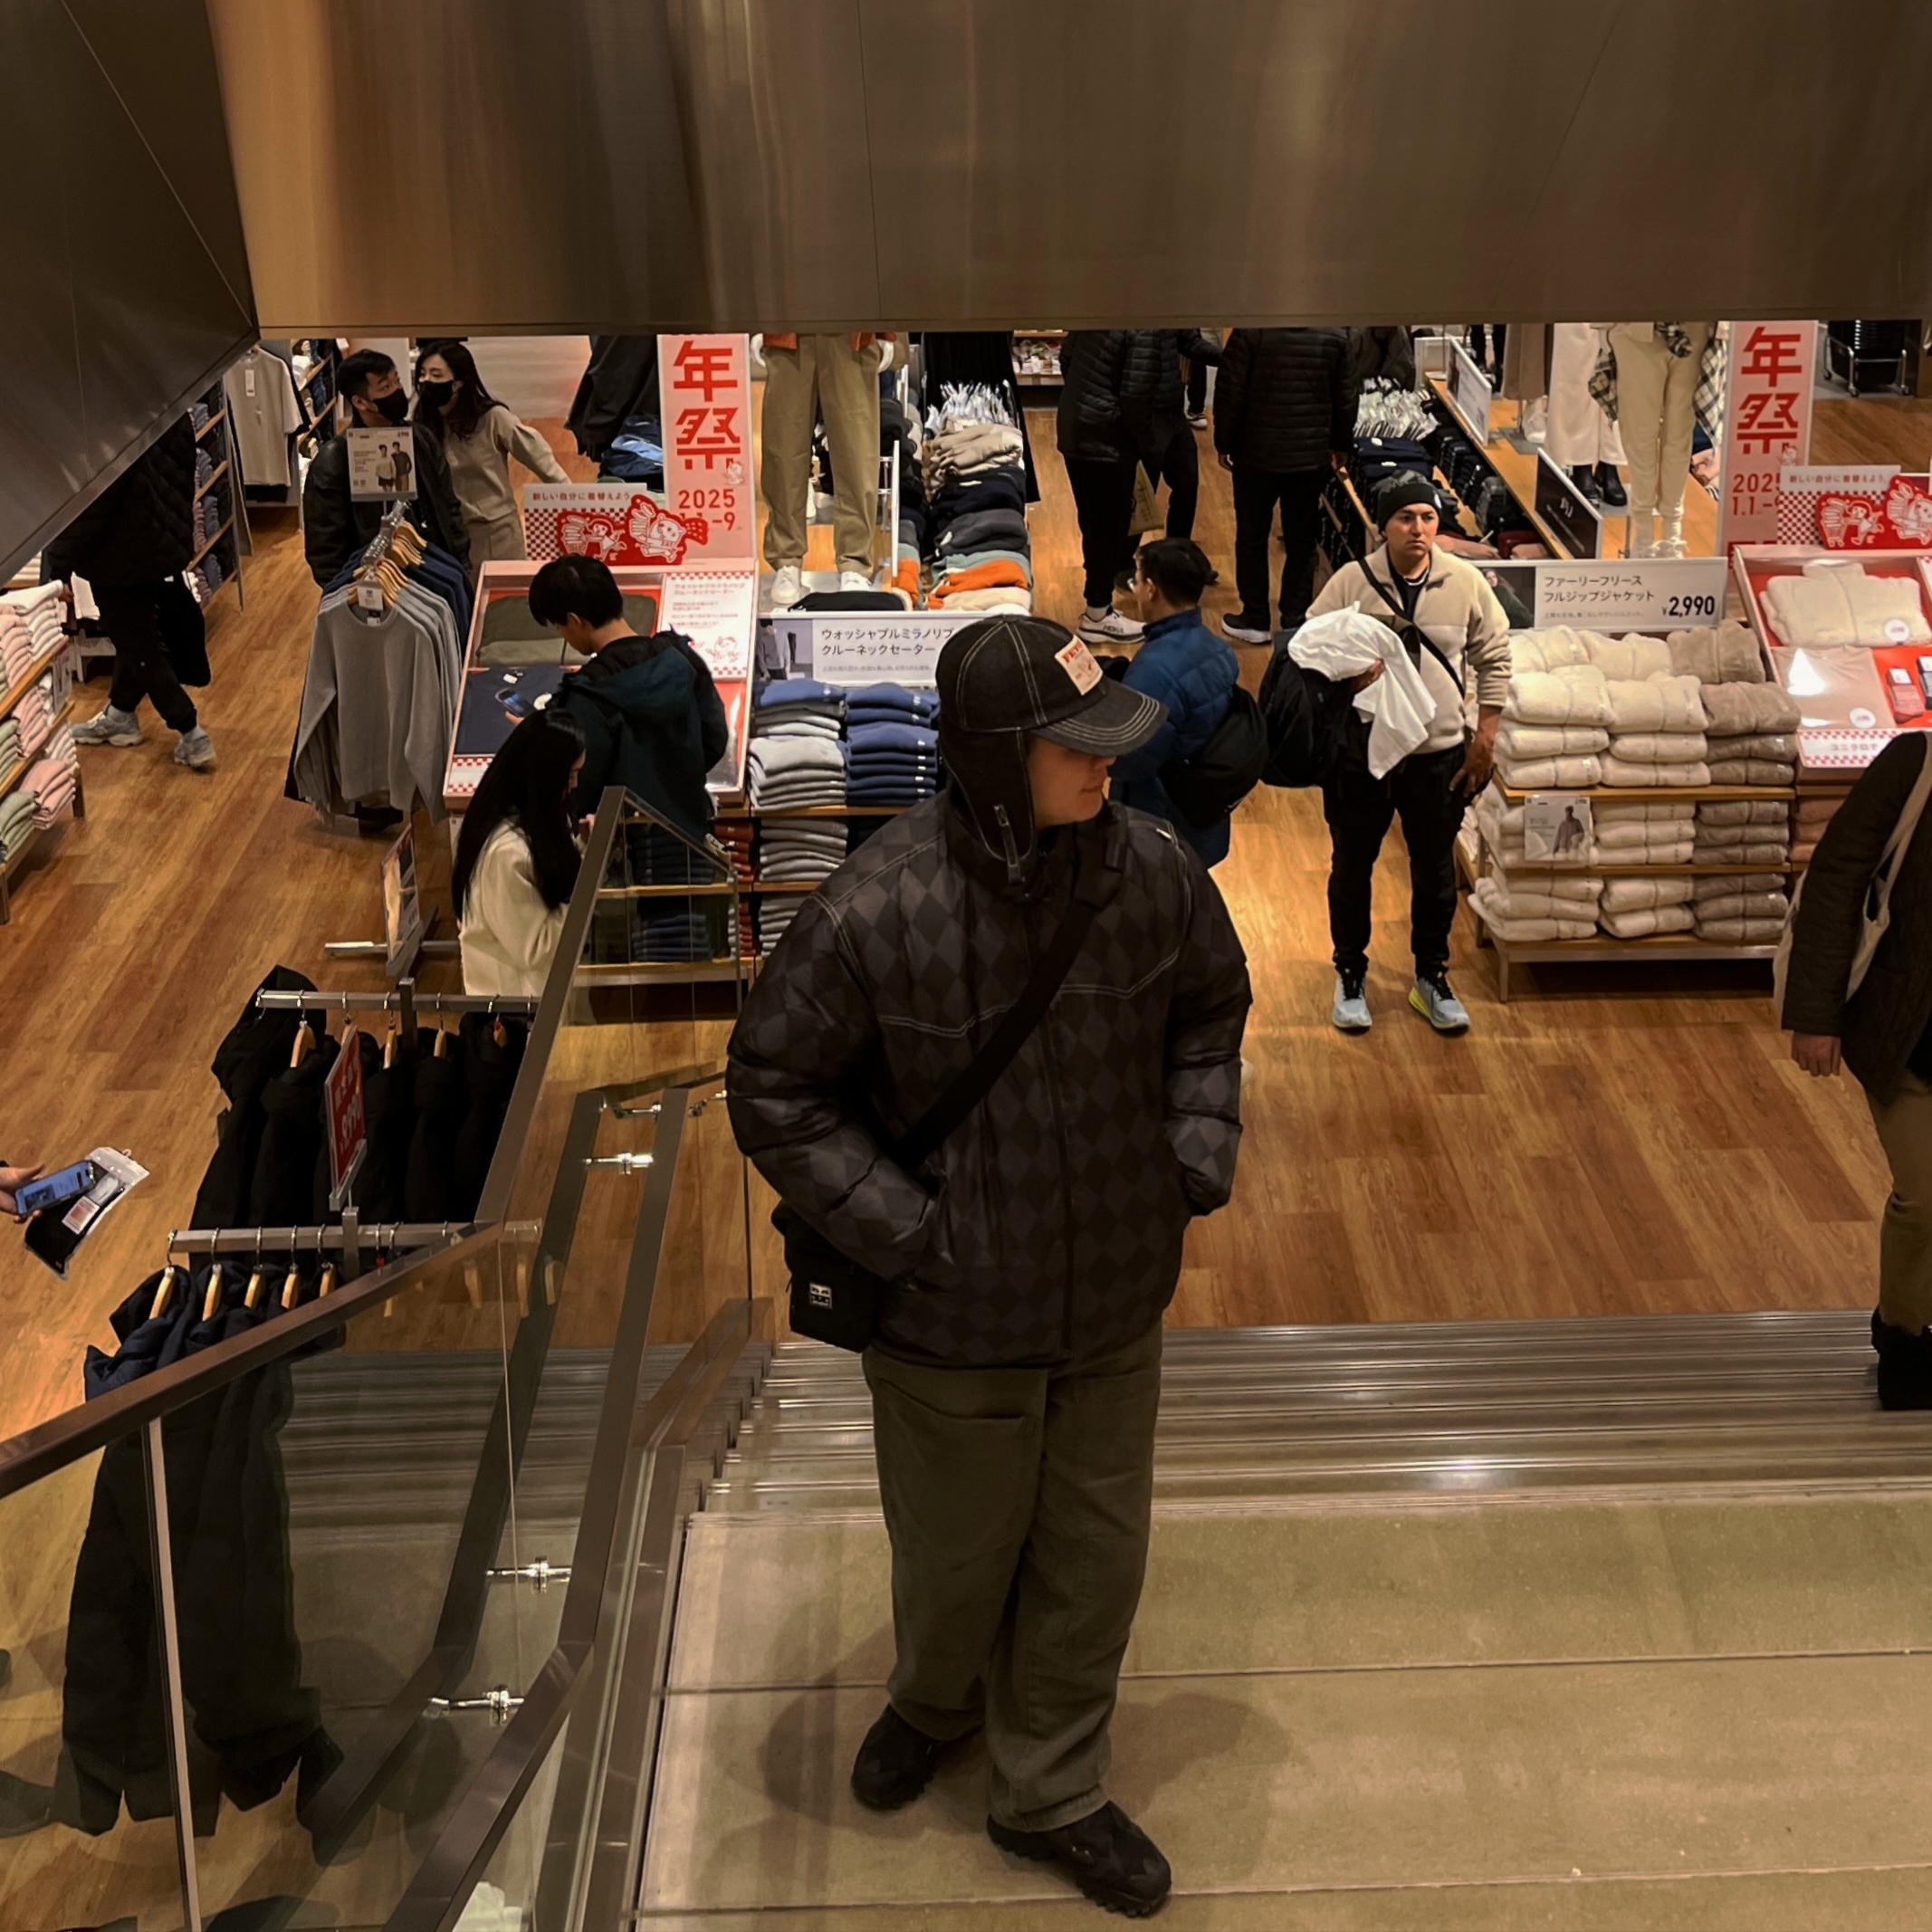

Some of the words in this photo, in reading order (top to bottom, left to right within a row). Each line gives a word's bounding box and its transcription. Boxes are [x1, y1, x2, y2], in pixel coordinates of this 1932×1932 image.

[678, 488, 735, 509] 2025
[1544, 575, 1643, 588] ファーリーフリース
[1544, 591, 1655, 603] フルジップジャケット
[1661, 595, 1716, 618] ¥2,990
[822, 644, 935, 655] クルーネックセーター
